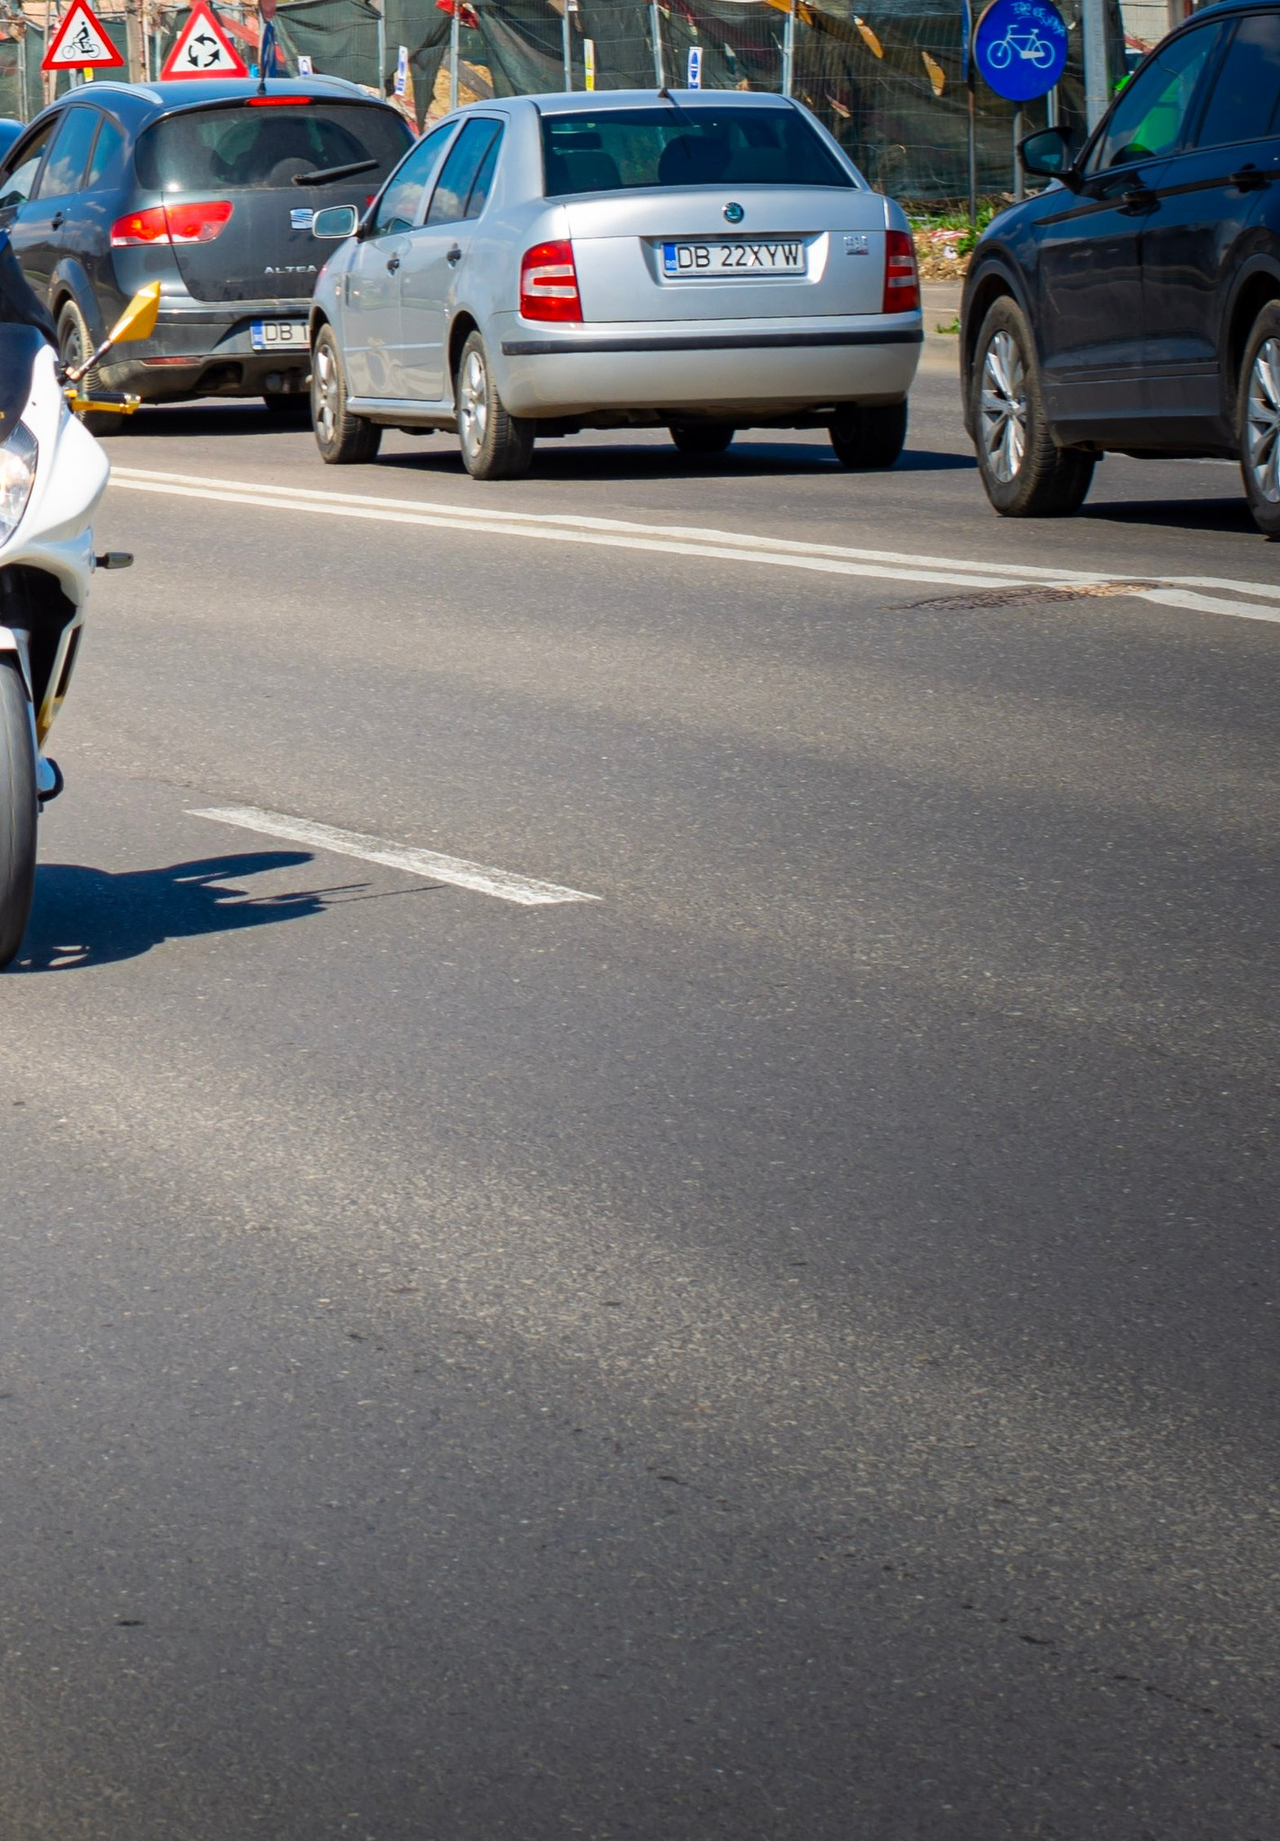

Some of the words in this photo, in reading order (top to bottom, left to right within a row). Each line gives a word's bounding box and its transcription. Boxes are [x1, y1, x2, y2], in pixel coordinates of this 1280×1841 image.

[677, 246, 710, 268] DB
[264, 264, 318, 274] ALTEA
[264, 322, 293, 341] DB
